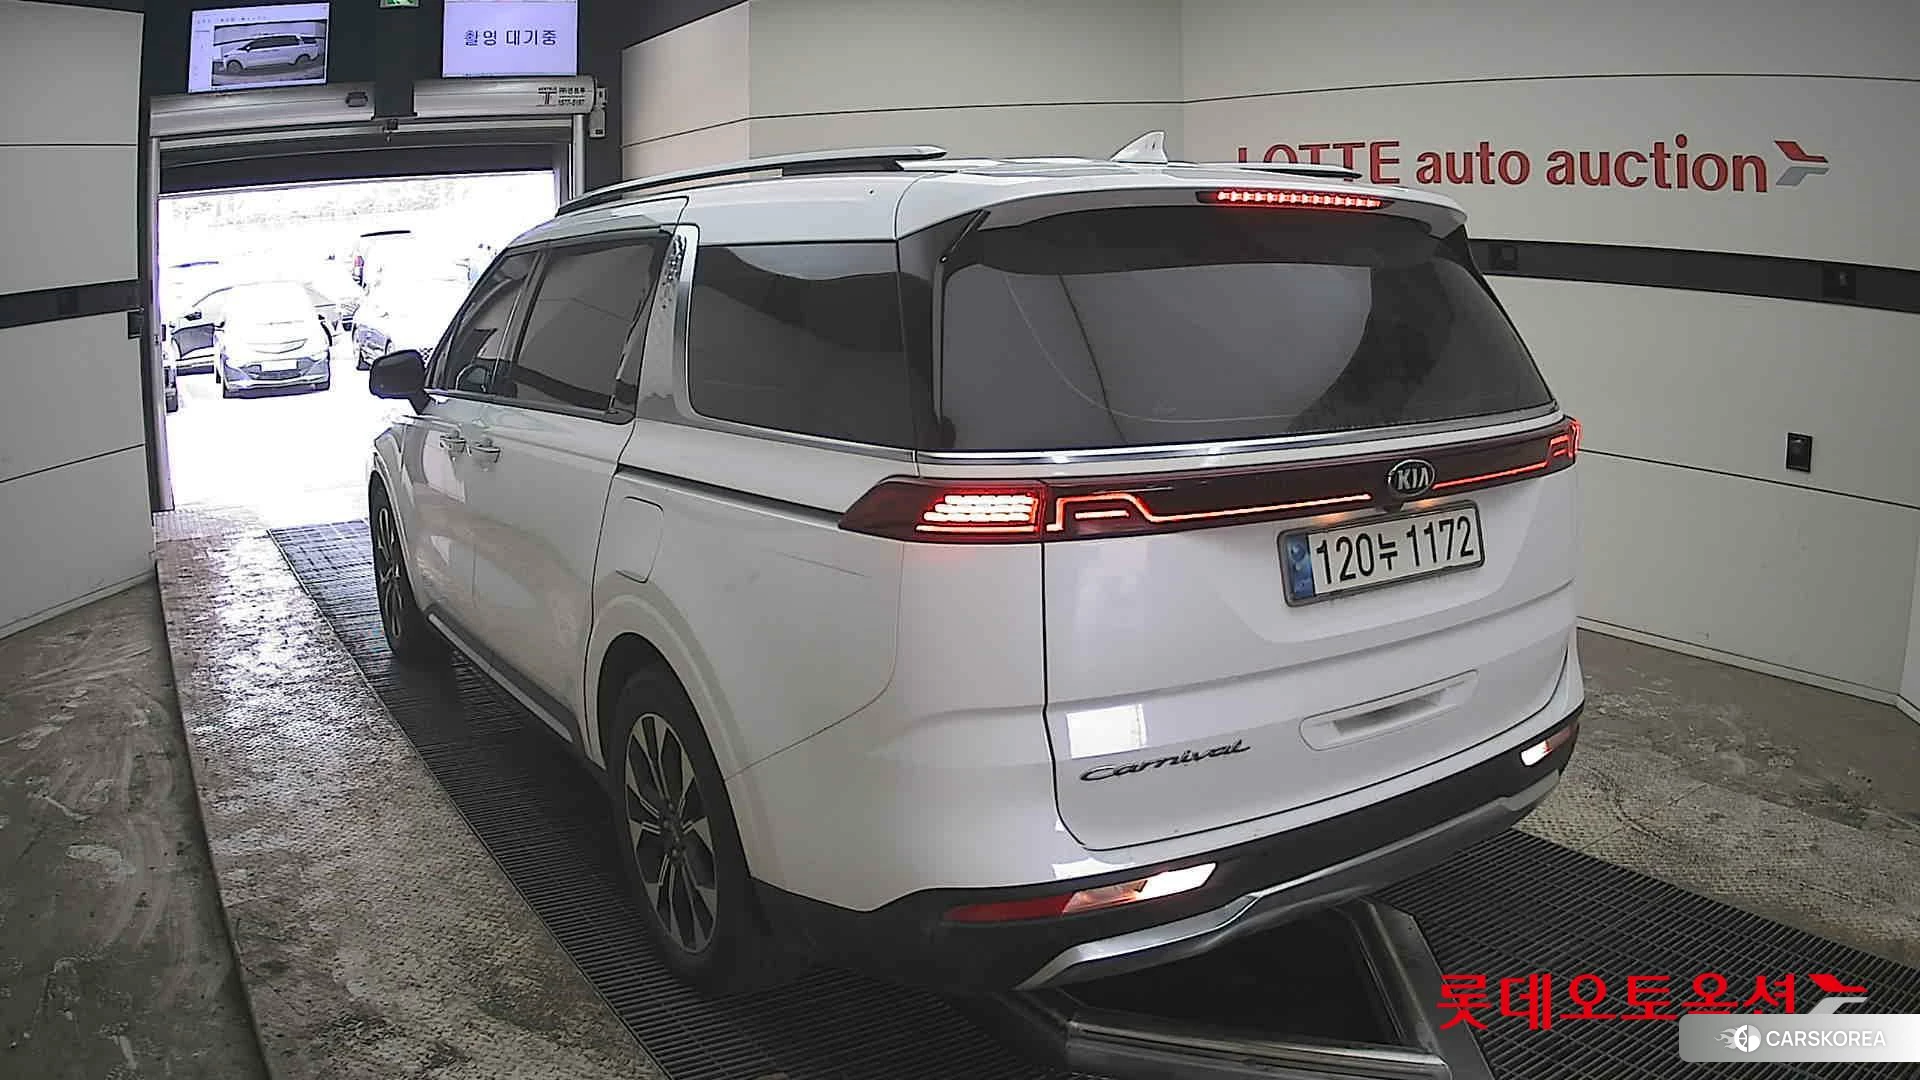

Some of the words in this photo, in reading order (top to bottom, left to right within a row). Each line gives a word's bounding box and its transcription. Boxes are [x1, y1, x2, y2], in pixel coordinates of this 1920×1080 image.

[505, 30, 557, 46] 대기중
[1416, 141, 1531, 186] auto
[1546, 134, 1767, 193] auction
[1397, 472, 1430, 490] KIA
[1316, 532, 1398, 585] 120누
[1406, 516, 1474, 567] 1172
[1080, 739, 1251, 781] Carnival
